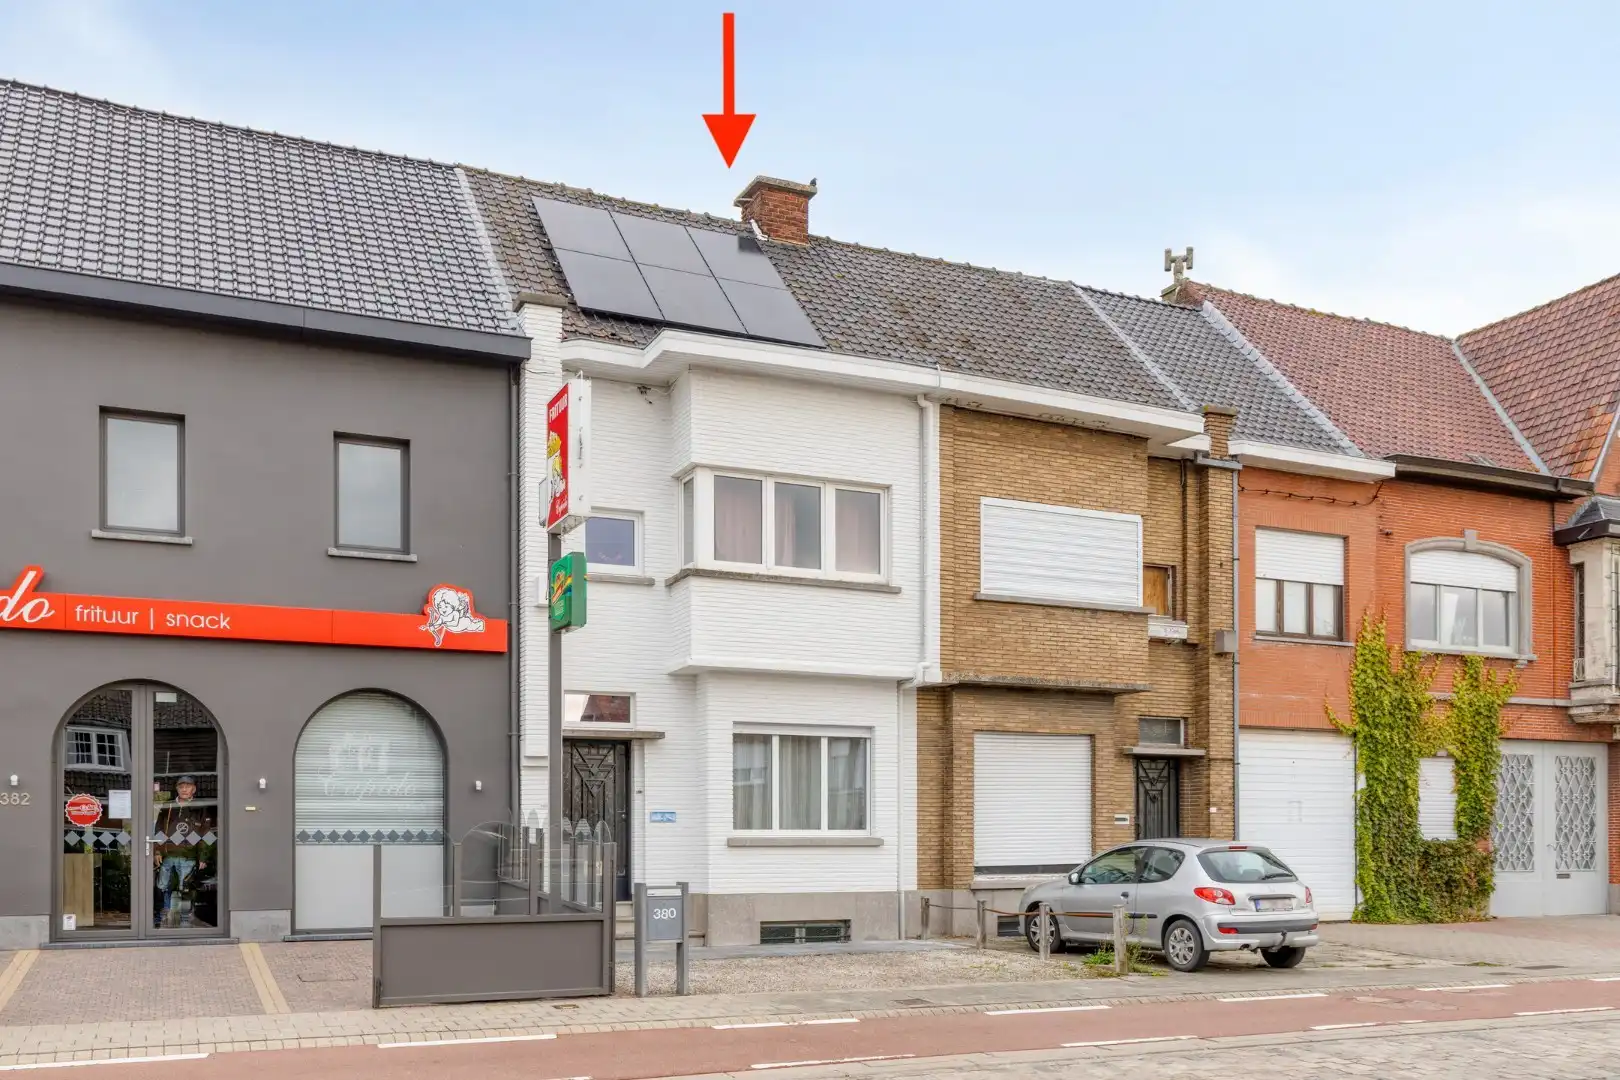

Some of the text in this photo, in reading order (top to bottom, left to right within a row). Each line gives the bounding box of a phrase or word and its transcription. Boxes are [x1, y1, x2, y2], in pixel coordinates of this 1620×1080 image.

[75, 604, 231, 630] frituur snack
[0, 792, 31, 806] 382
[653, 907, 677, 920] 380
